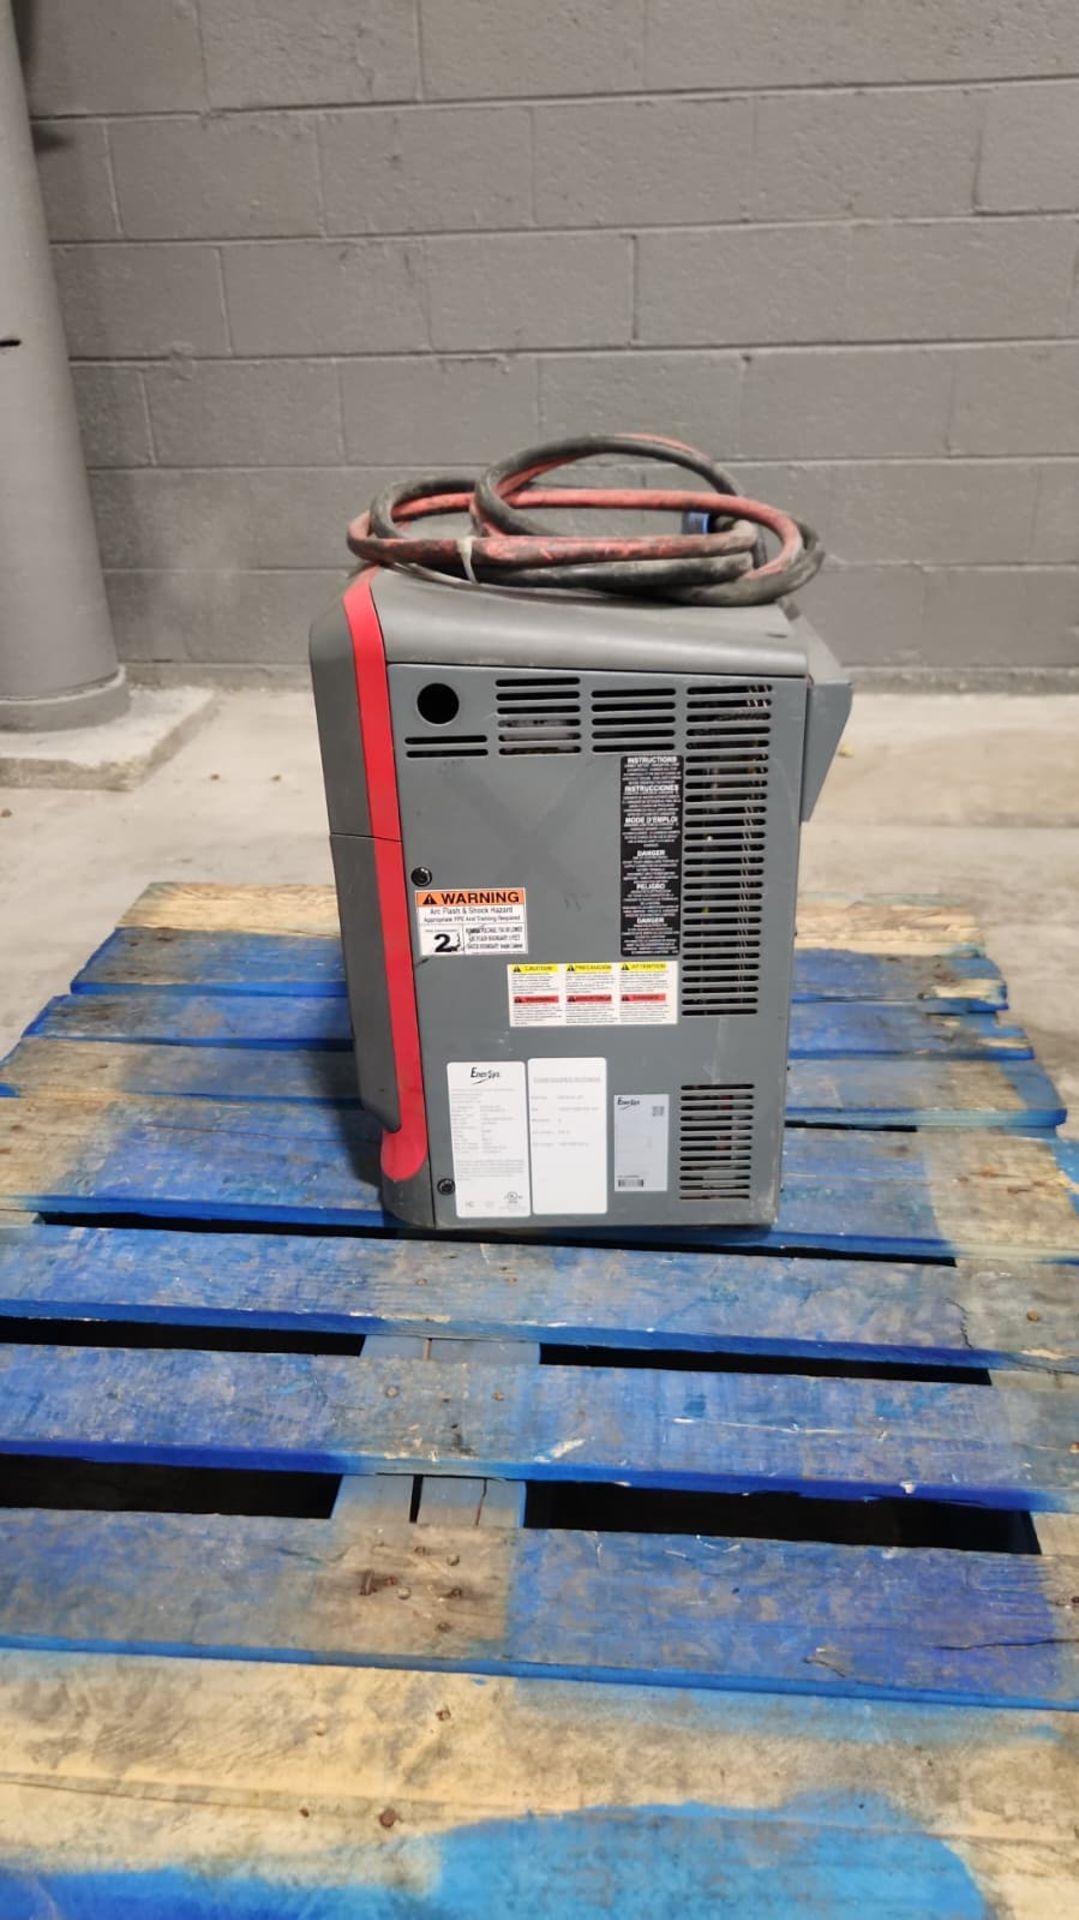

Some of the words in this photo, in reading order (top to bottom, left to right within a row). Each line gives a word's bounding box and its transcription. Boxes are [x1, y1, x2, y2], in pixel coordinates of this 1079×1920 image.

[627, 756, 677, 764] INSTRUCTIONS
[625, 816, 645, 824] MODE
[441, 892, 519, 905] WARNING
[434, 933, 451, 953] 2
